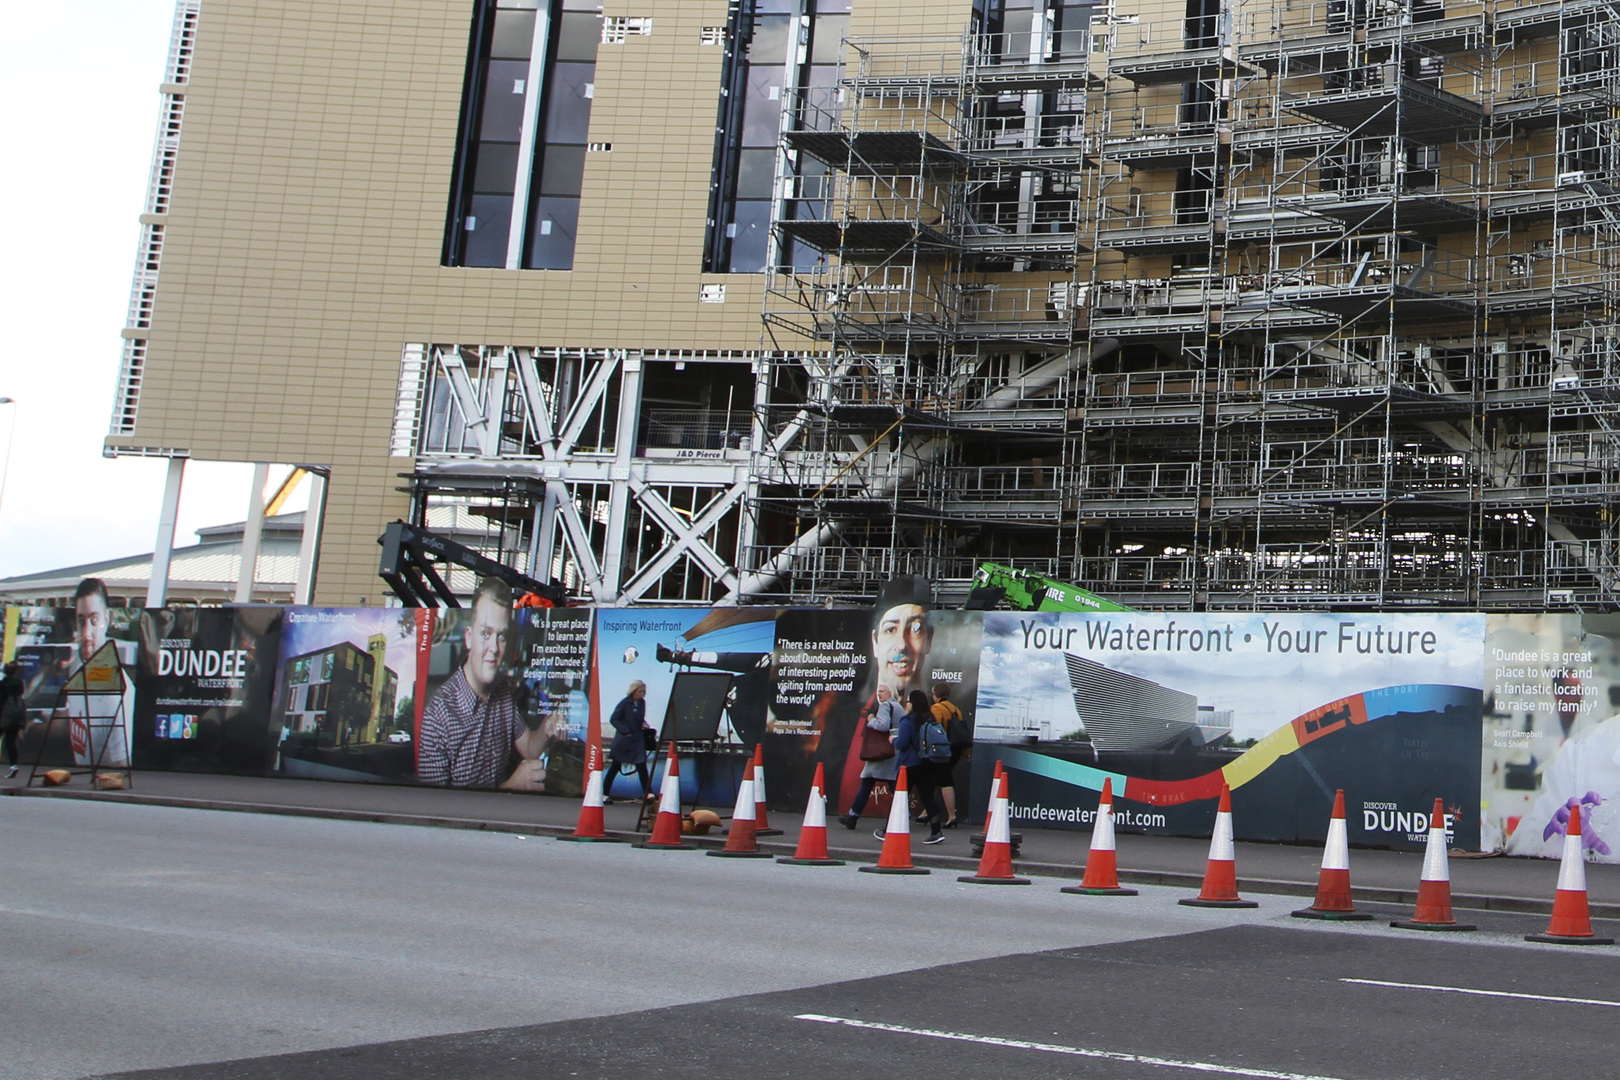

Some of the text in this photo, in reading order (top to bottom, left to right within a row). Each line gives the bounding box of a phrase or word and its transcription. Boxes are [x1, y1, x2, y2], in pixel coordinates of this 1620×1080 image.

[1074, 595, 1100, 609] 01944
[289, 611, 356, 623] Creative Waterfront
[420, 608, 431, 652] The Brae
[551, 620, 570, 631] great
[570, 620, 589, 631] place
[603, 620, 682, 634] Inspiring Waterfront
[548, 631, 588, 641] to learn and
[1020, 620, 1437, 654] Your Waterfront Your Future
[545, 644, 569, 654] excited
[570, 645, 577, 653] to
[578, 645, 587, 654] be
[804, 639, 811, 650] is
[812, 641, 817, 650] a
[818, 640, 834, 650] real
[835, 640, 855, 650] buzz
[531, 657, 545, 668] part
[779, 653, 867, 664] about Dundee with lots
[1541, 650, 1550, 662] is
[1552, 652, 1559, 662] a
[1562, 650, 1592, 664] great
[158, 650, 248, 677] DUNDEE
[523, 668, 547, 681] design
[778, 666, 856, 680] of interesting people
[931, 671, 963, 680] DUNDEE
[1495, 665, 1593, 680] place to work and
[777, 680, 853, 694] visiting from around
[1394, 685, 1420, 695] PORT
[1494, 682, 1598, 696] a fantastic location
[776, 694, 788, 704] the
[1325, 697, 1350, 711] QUAY
[1494, 700, 1505, 710] to
[1508, 699, 1535, 711] raise
[1538, 702, 1556, 714] my
[774, 719, 789, 727] James
[1493, 729, 1543, 739] Geoff Campbell
[1493, 740, 1529, 748] Axis Shield
[588, 745, 598, 770] Quay
[1162, 792, 1185, 803] BRAE
[1364, 802, 1398, 810] DISCOVER
[1363, 810, 1454, 835] DUNDE
